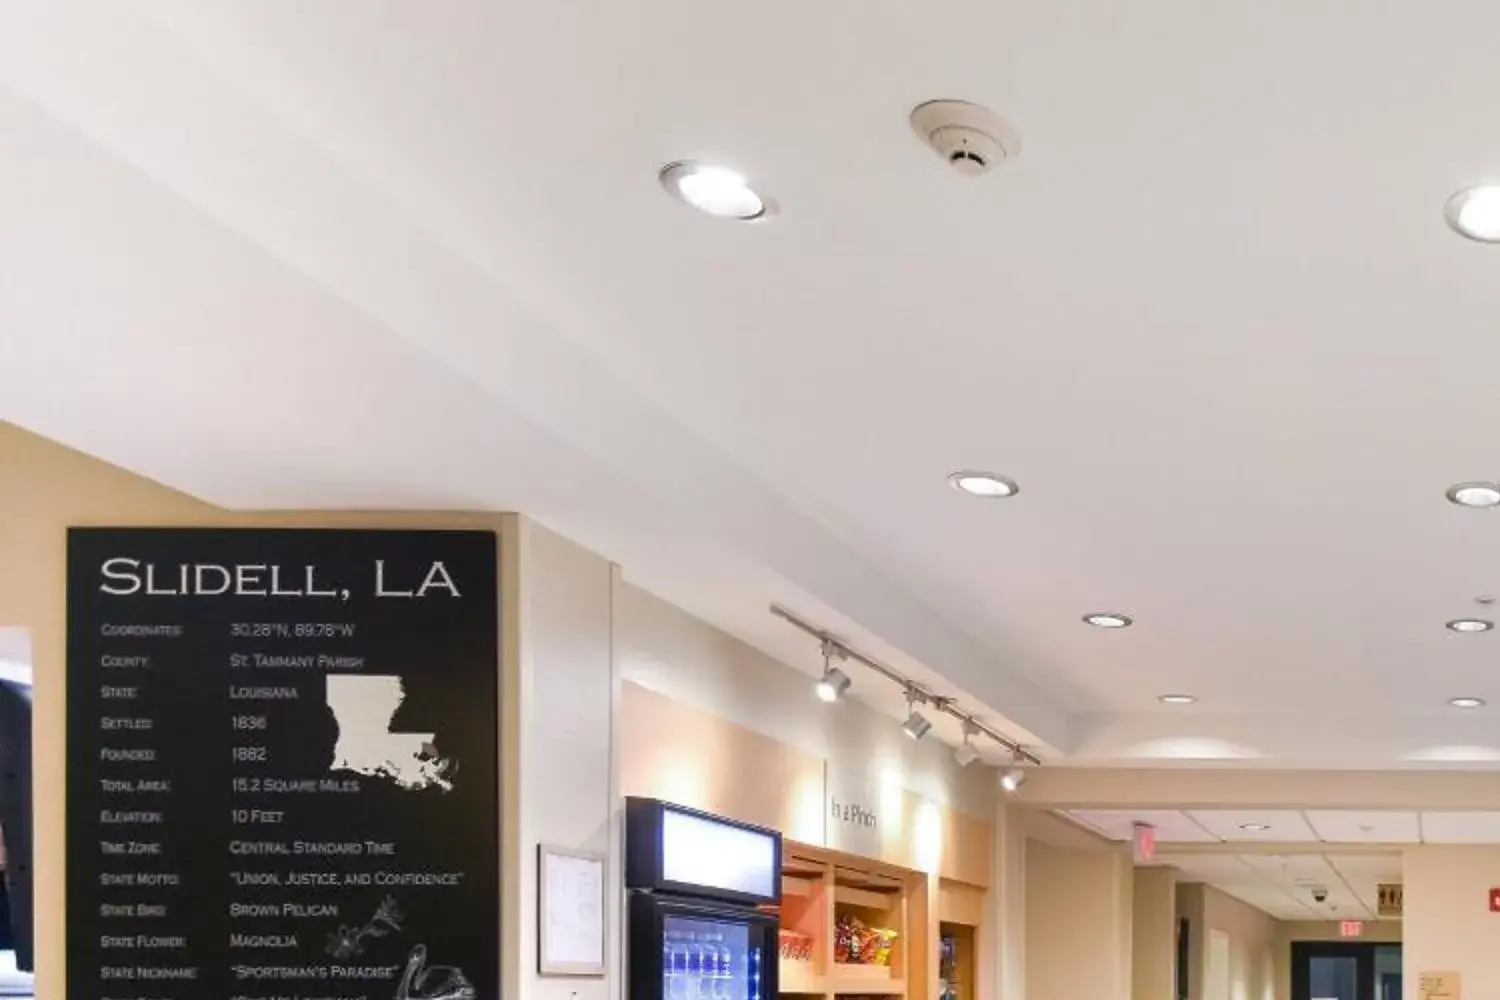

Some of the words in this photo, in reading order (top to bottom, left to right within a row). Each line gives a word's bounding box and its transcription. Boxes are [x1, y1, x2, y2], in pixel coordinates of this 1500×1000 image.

[100, 557, 350, 600] SLIDELL,
[375, 560, 461, 597] LA
[345, 873, 371, 886] AND
